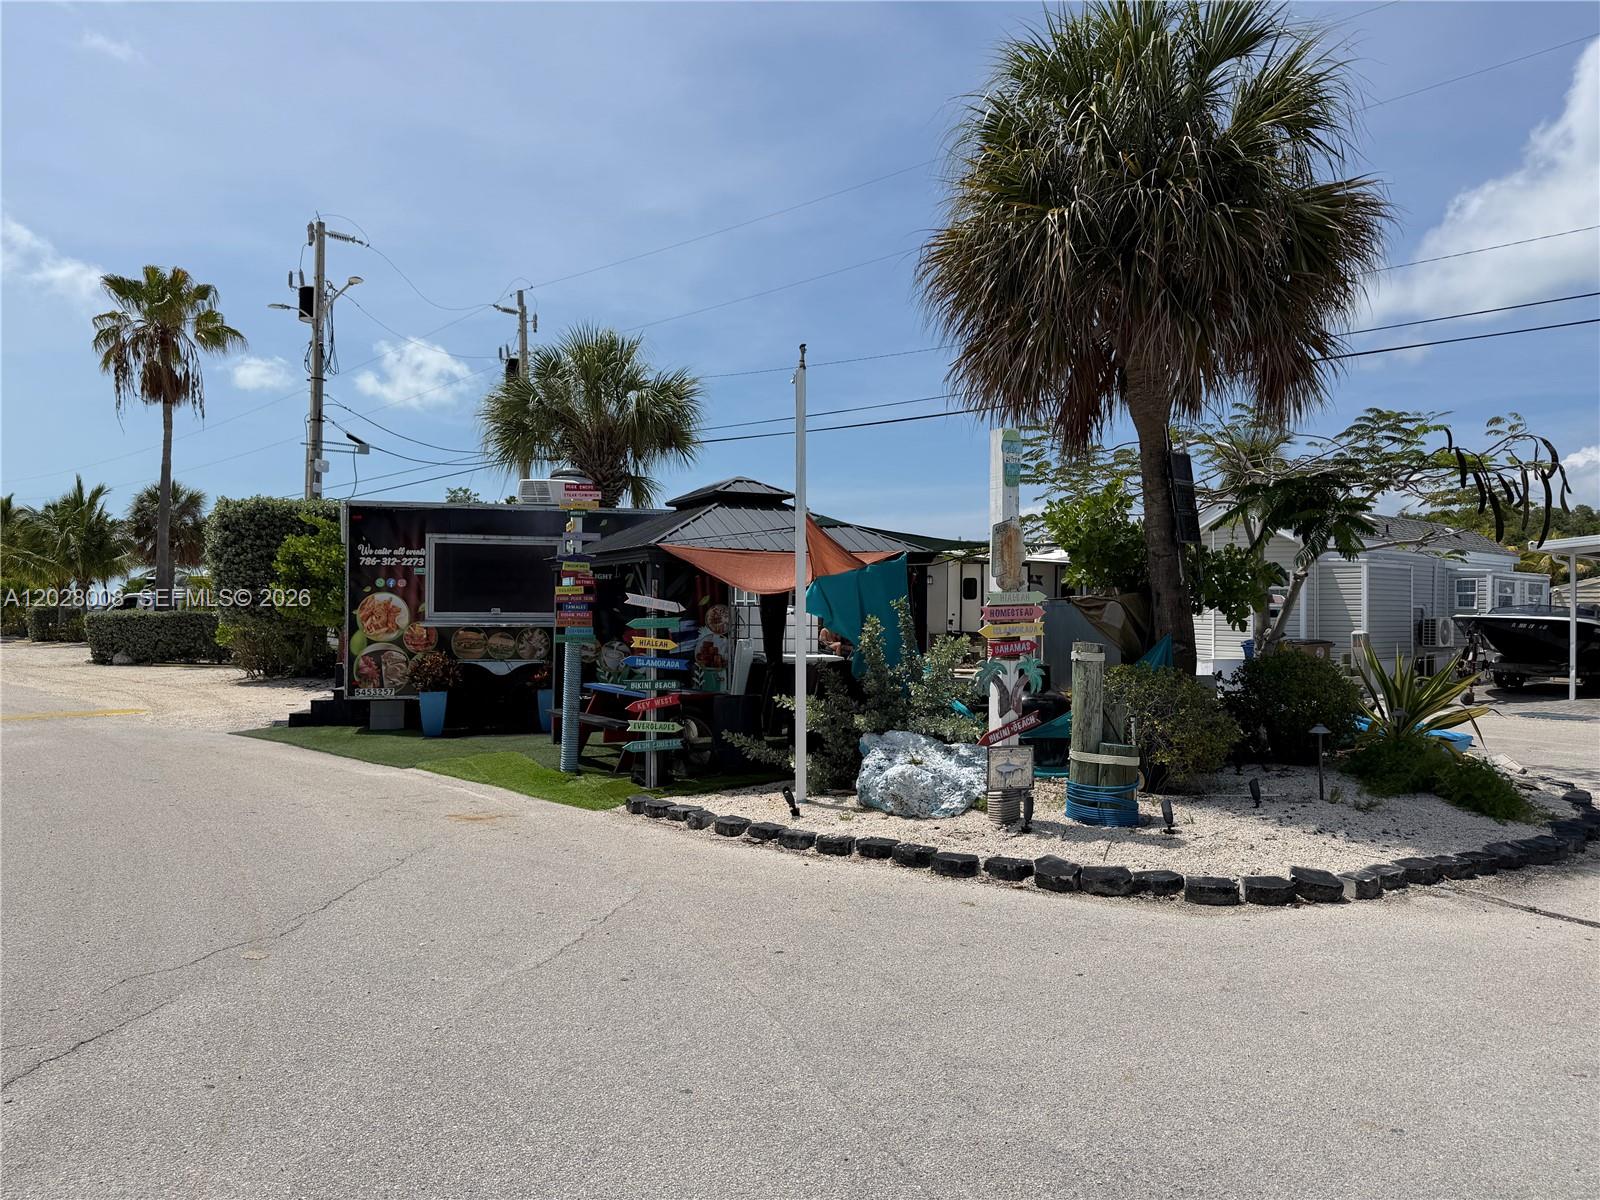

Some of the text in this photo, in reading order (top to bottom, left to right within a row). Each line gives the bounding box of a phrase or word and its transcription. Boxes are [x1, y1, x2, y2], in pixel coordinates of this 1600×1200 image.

[357, 543, 374, 556] We
[374, 547, 392, 555] cater
[393, 546, 406, 555] all
[359, 557, 424, 566] 786-312-2273
[999, 593, 1031, 602] HIALEAH
[989, 607, 1034, 618] HOMESTEAD
[992, 624, 1038, 635] ISLAMORADA
[639, 639, 668, 648] HIALEAH
[994, 641, 1031, 654] BAHAMAS
[635, 658, 680, 668] ISLAMORADA
[630, 681, 677, 689] BIKINI BEACH
[356, 688, 393, 696] 5453257
[637, 695, 673, 710] KEY WEST
[633, 722, 675, 731] EVERGLADES
[988, 715, 1036, 743] BIKINI BEACH
